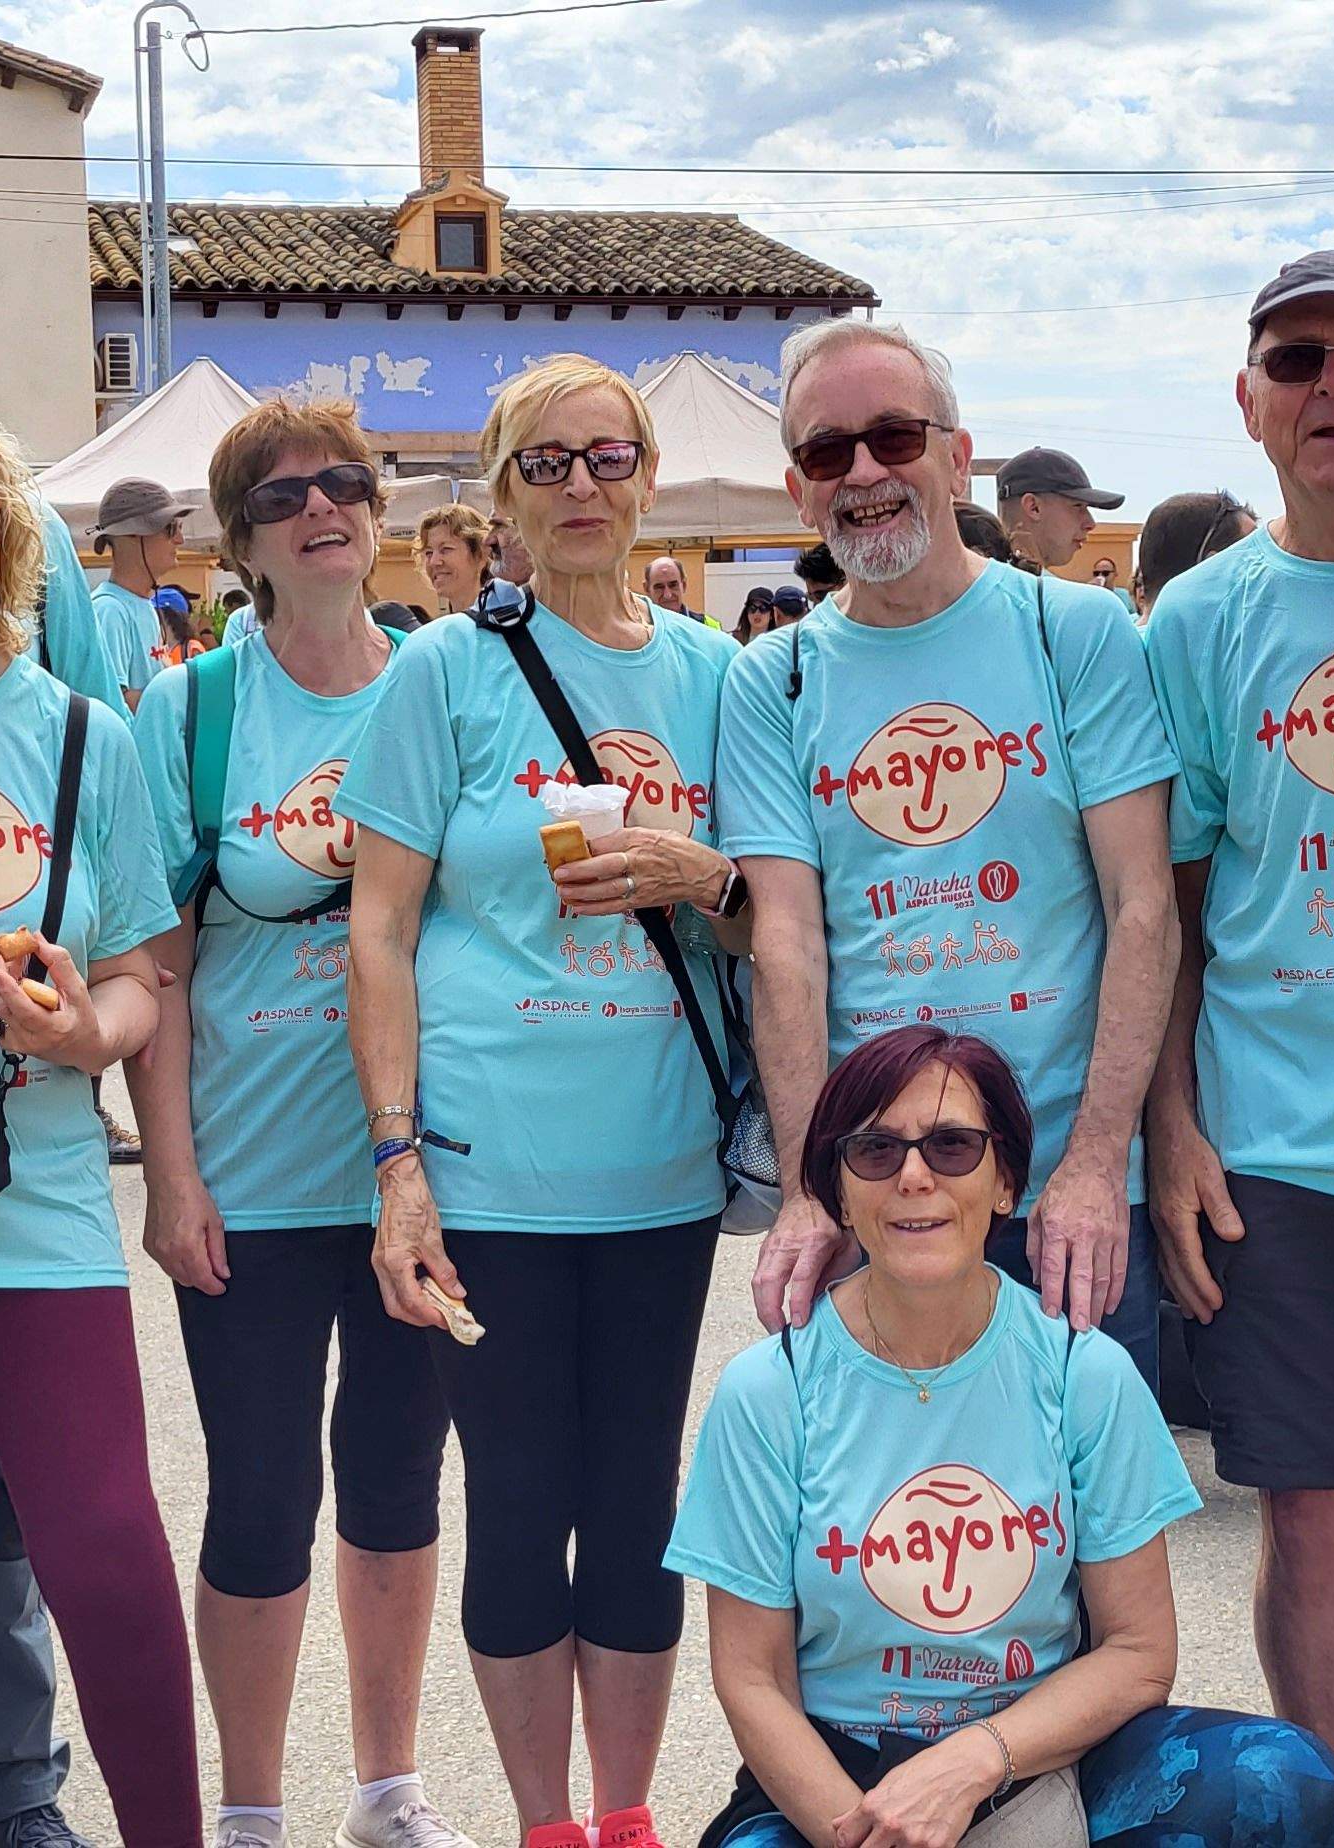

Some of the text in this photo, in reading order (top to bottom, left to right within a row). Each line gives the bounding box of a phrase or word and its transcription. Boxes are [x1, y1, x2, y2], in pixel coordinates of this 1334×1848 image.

[813, 723, 1047, 811] +mayores
[903, 871, 973, 898] Marcha
[906, 890, 973, 910] ASPACE HUESCA
[816, 1491, 1066, 1593] +mayores
[922, 1647, 1000, 1674] Marcha
[923, 1670, 999, 1685] ASPACE HUESCA
